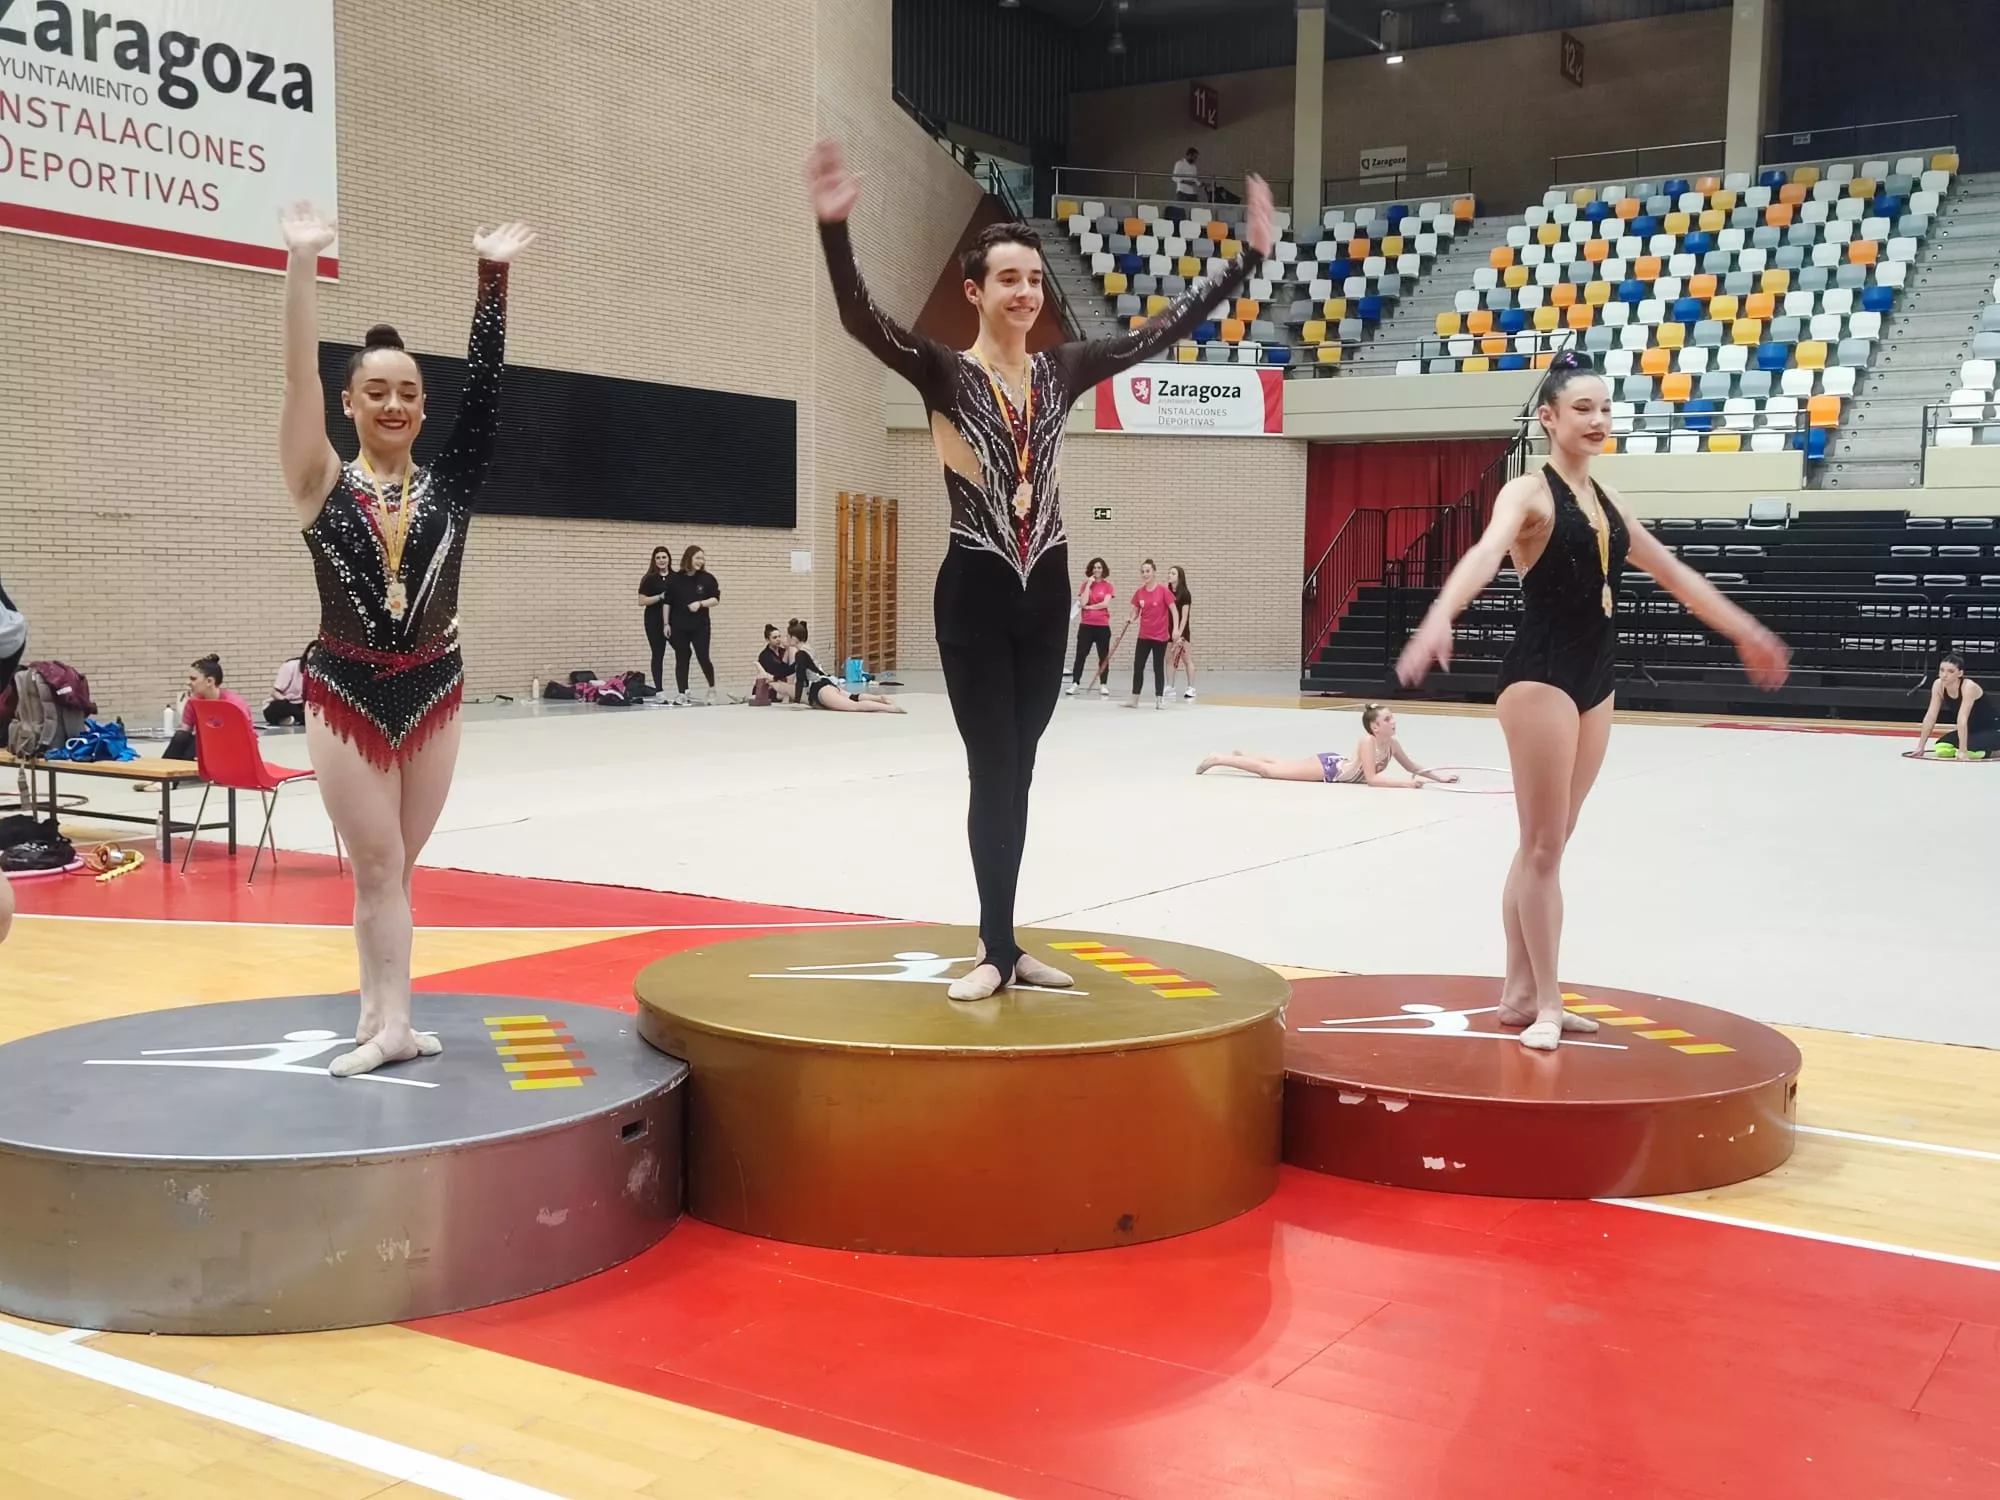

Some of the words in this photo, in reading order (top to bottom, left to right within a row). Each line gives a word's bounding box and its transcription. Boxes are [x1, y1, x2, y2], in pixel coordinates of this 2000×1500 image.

[1564, 41, 1576, 75] 12
[1194, 88, 1206, 118] 11
[1158, 380, 1241, 403] Zaragoza
[1158, 406, 1228, 417] INSTALACIONES
[1158, 416, 1216, 426] DEPORTIVAS
